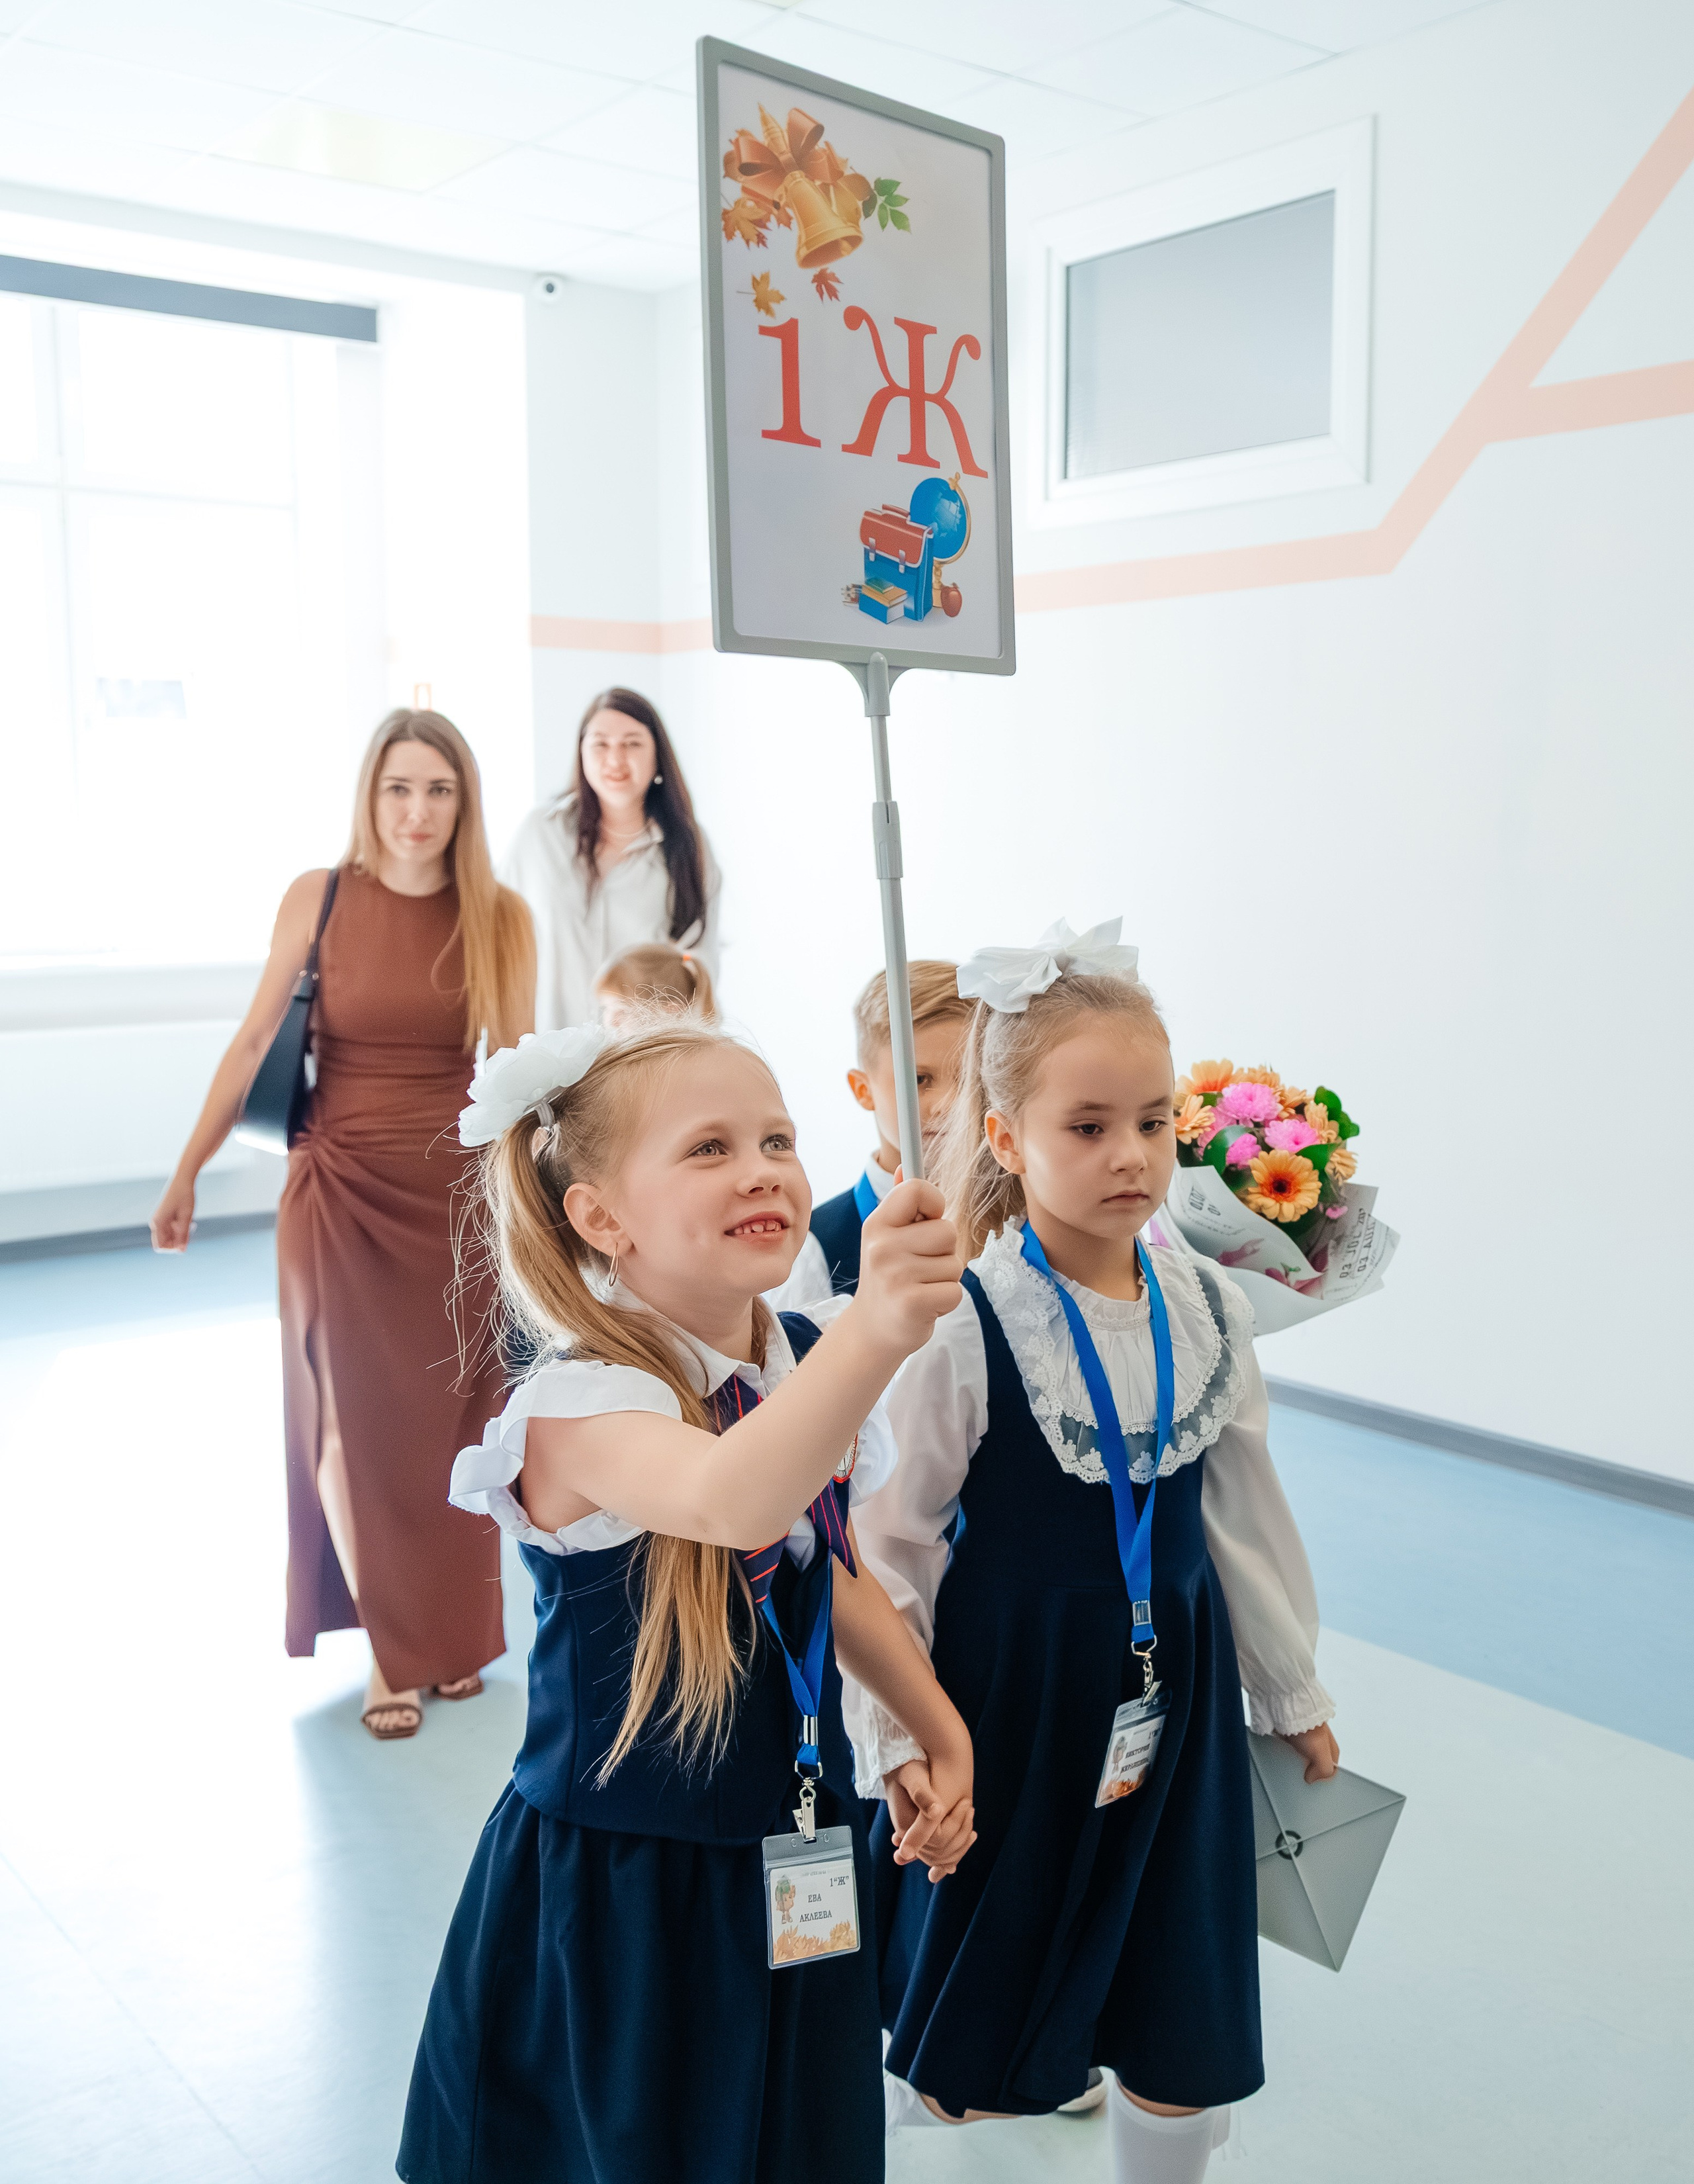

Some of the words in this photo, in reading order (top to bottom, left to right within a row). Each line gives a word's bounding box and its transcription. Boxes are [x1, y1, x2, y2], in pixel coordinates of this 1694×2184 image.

[758, 317, 822, 449] 1
[842, 304, 989, 479] Ж
[808, 1893, 822, 1903] ЕВА
